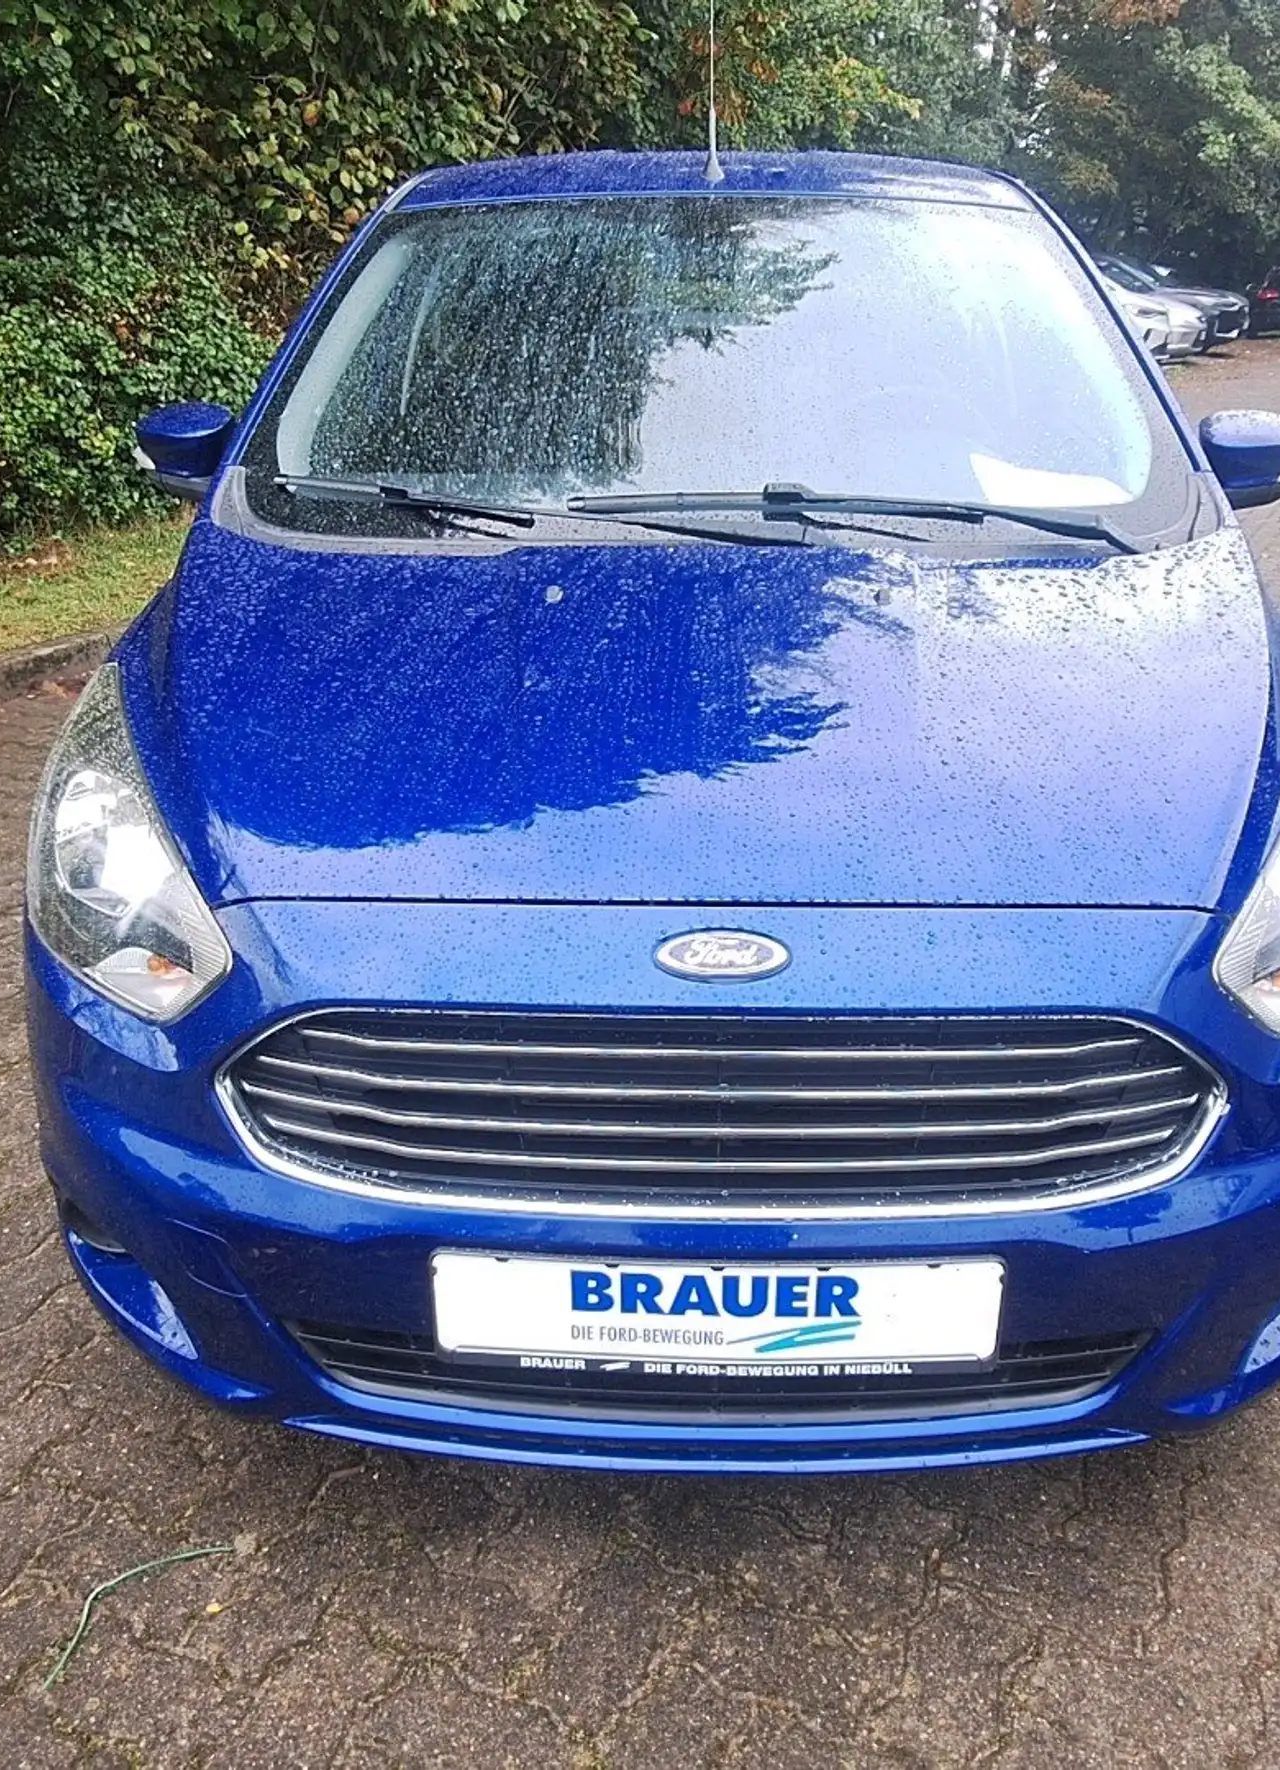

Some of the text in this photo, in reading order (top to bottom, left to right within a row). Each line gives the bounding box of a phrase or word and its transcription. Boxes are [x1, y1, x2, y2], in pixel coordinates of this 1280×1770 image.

[684, 938, 759, 965] Ford
[571, 1270, 861, 1317] BRAUER
[571, 1324, 724, 1346] DIE FORD-BEWEGUNG
[520, 1357, 912, 1377] BRAUER DIE FORD-BEWEGUNG IN NIEBÜLL
